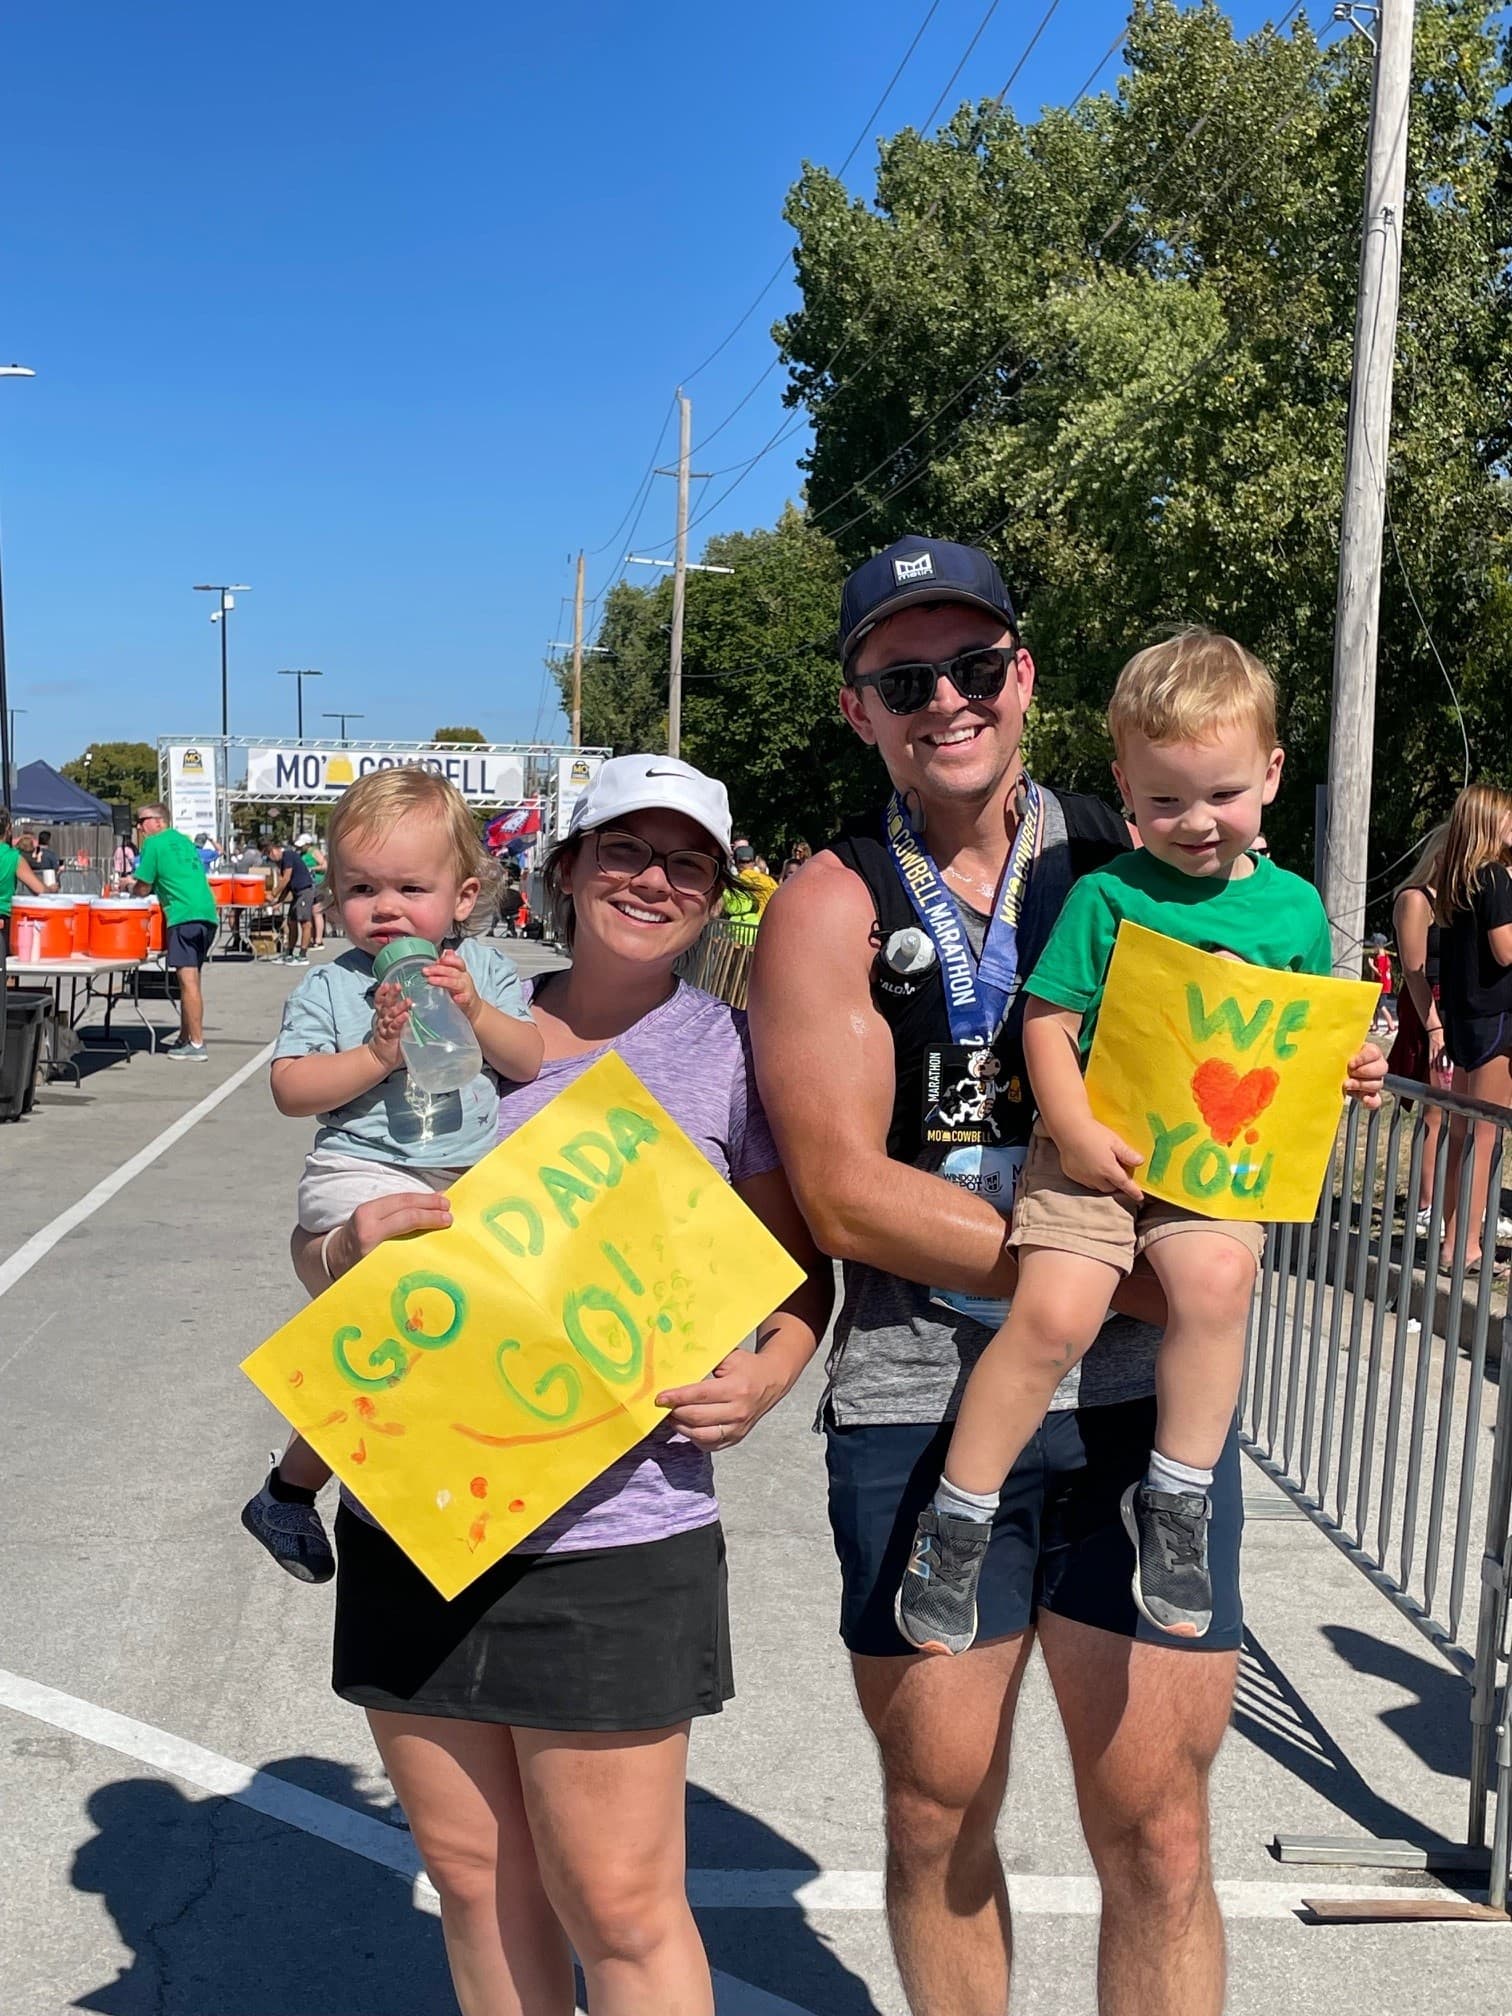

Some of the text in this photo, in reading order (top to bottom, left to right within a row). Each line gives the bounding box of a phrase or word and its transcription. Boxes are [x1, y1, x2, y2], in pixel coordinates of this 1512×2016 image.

[1012, 799, 1039, 882] COWBELL
[892, 829, 942, 908] COWBELL
[924, 902, 977, 1008] MARATHON
[1185, 981, 1310, 1061] WE
[928, 1052, 942, 1103] MARATHON
[951, 1130, 993, 1143] COWBELL
[1146, 1111, 1274, 1199] YOU
[332, 1106, 663, 1392] GO DADA
